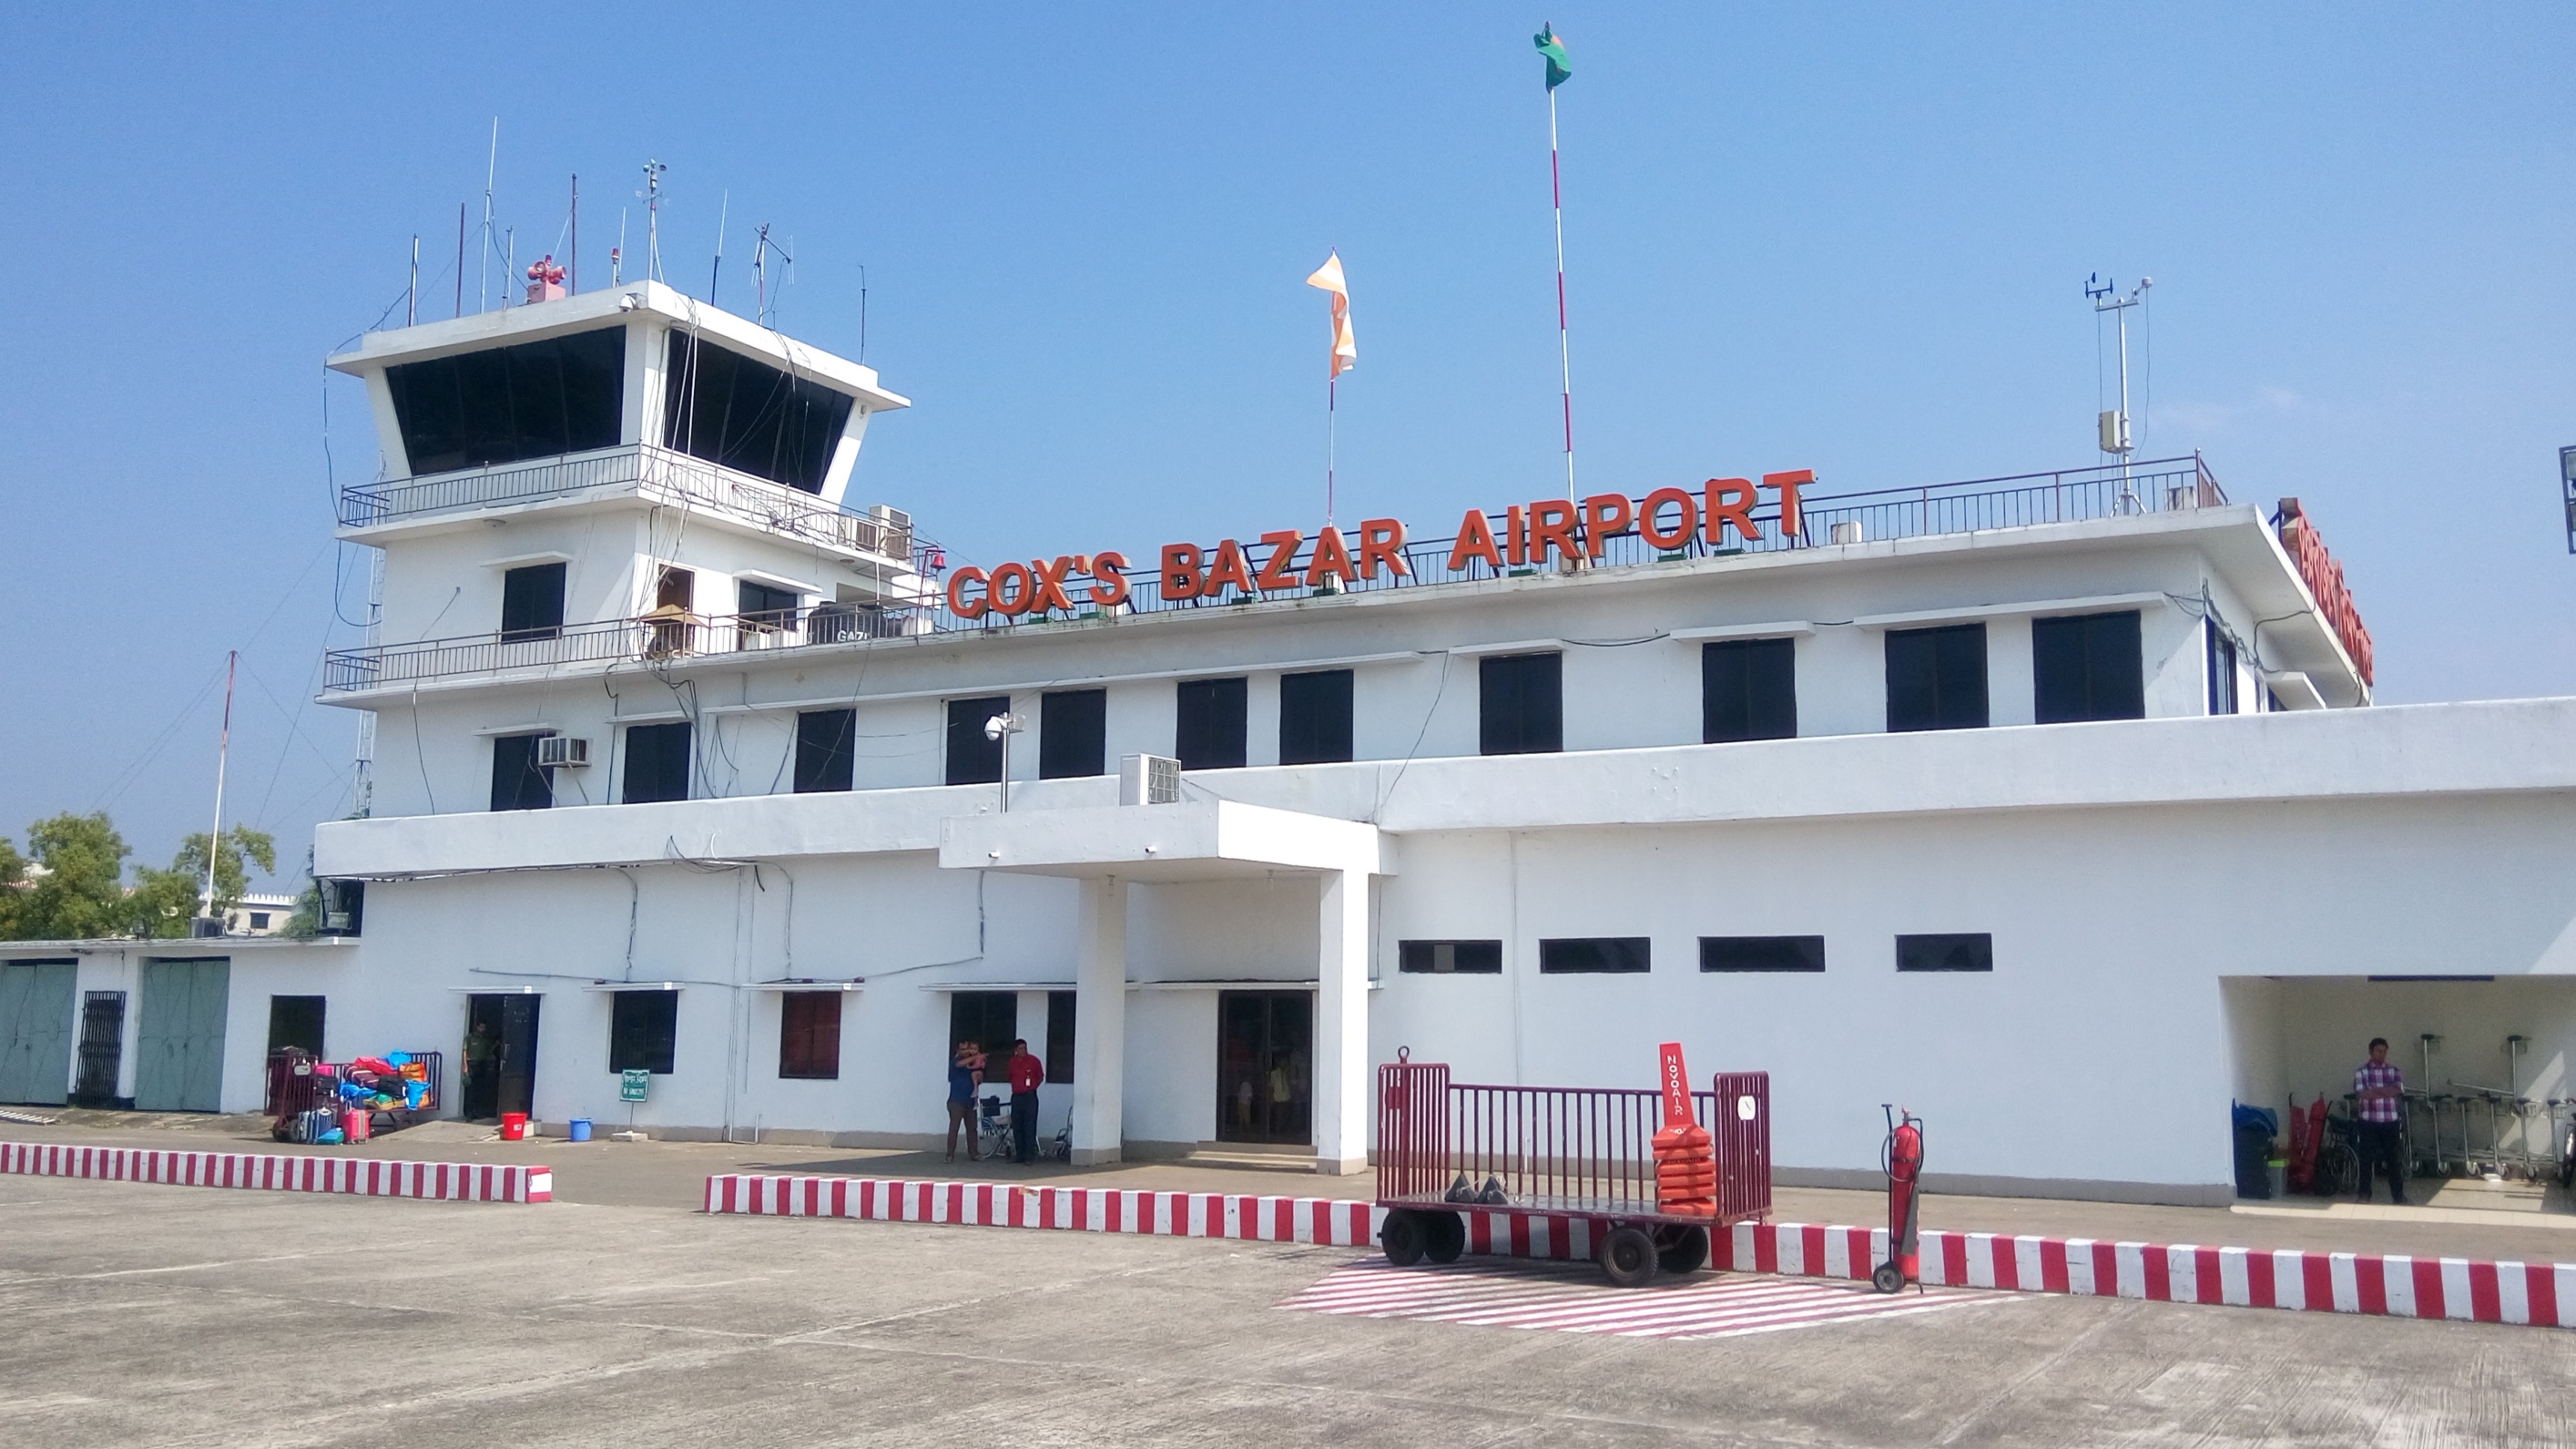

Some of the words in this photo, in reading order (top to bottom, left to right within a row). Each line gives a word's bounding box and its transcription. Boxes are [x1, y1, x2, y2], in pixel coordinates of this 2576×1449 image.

[948, 551, 1132, 620] COX'S
[1161, 519, 1410, 601] BAZAR
[1447, 469, 1816, 571] AIRPORT
[1667, 1055, 1683, 1115] NOVOAIR
